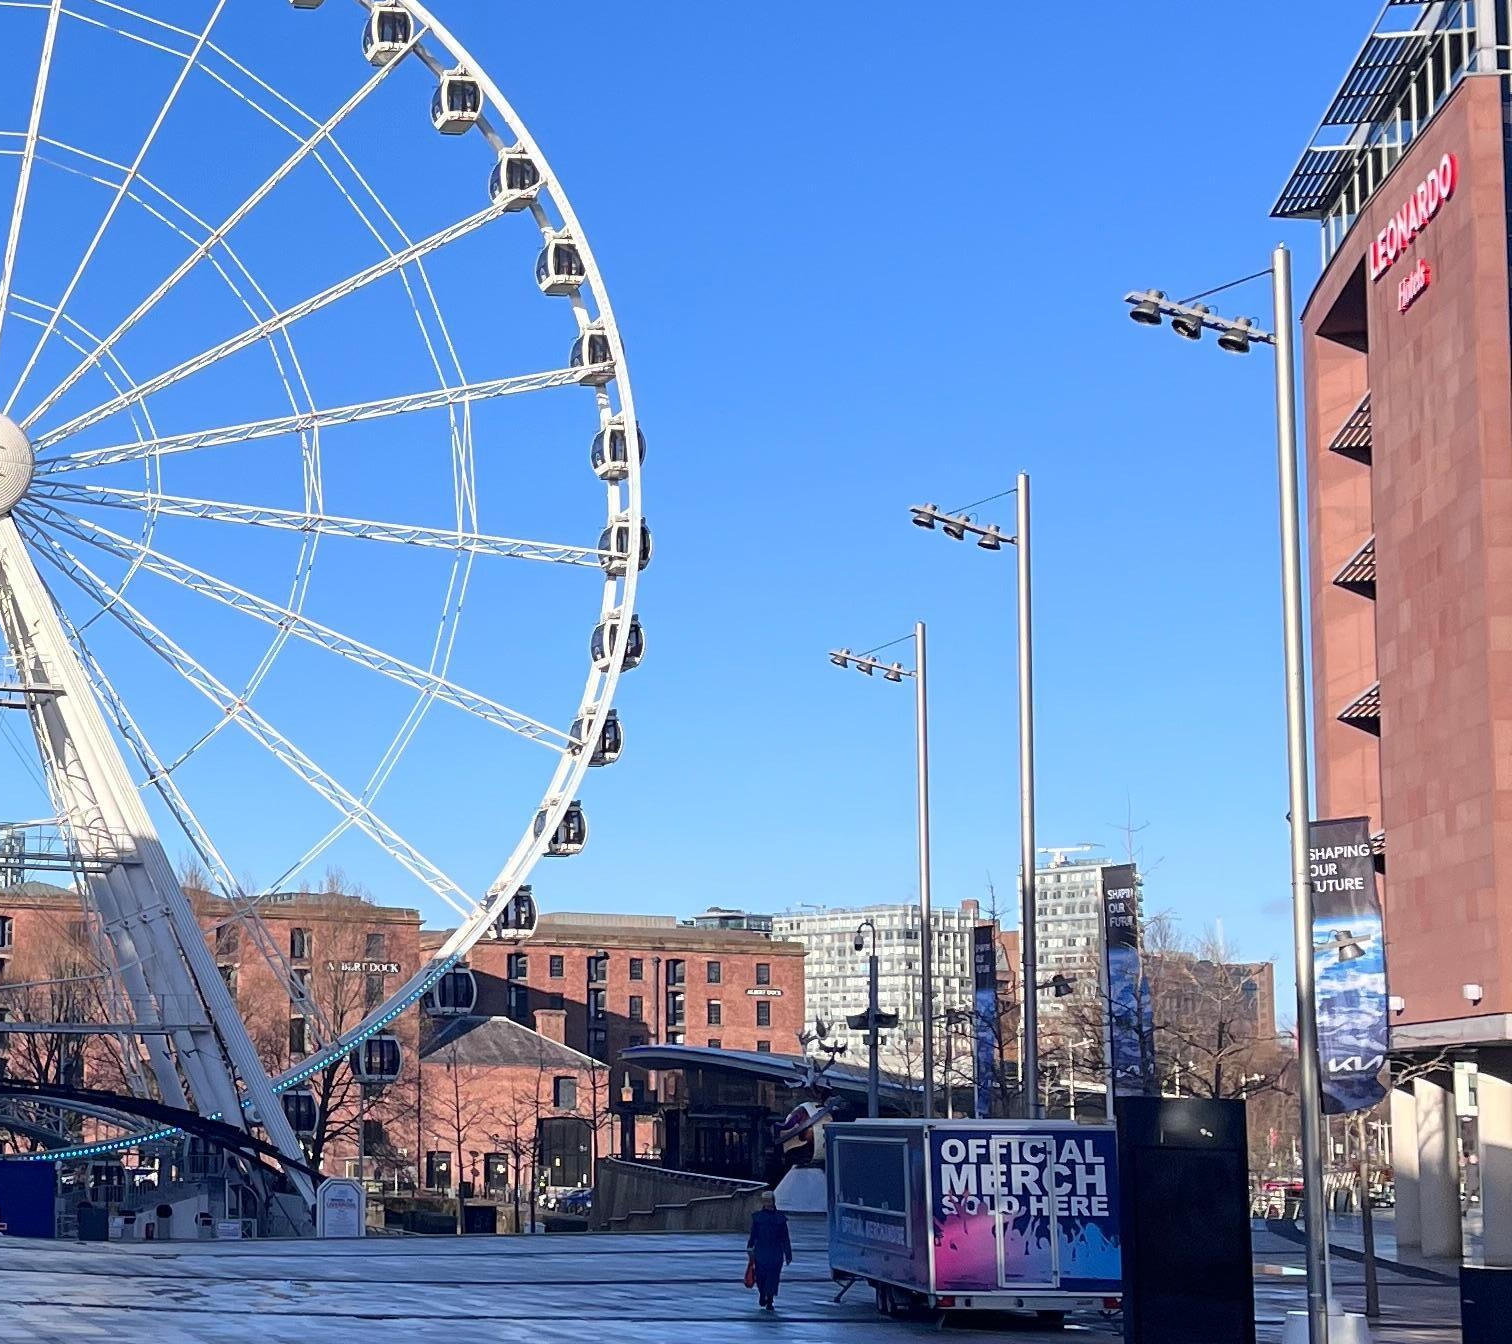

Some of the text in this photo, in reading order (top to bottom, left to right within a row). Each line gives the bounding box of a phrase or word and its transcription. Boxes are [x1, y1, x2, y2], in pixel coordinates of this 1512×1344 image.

[1369, 152, 1459, 282] LEONARDO
[1397, 256, 1431, 313] Hotels
[1309, 843, 1370, 861] SHAPING
[1108, 902, 1125, 914] OUR
[940, 1138, 1106, 1164] OFFICIAL
[940, 1163, 1108, 1196] MERCH
[941, 1195, 1110, 1217] SOLD HERE
